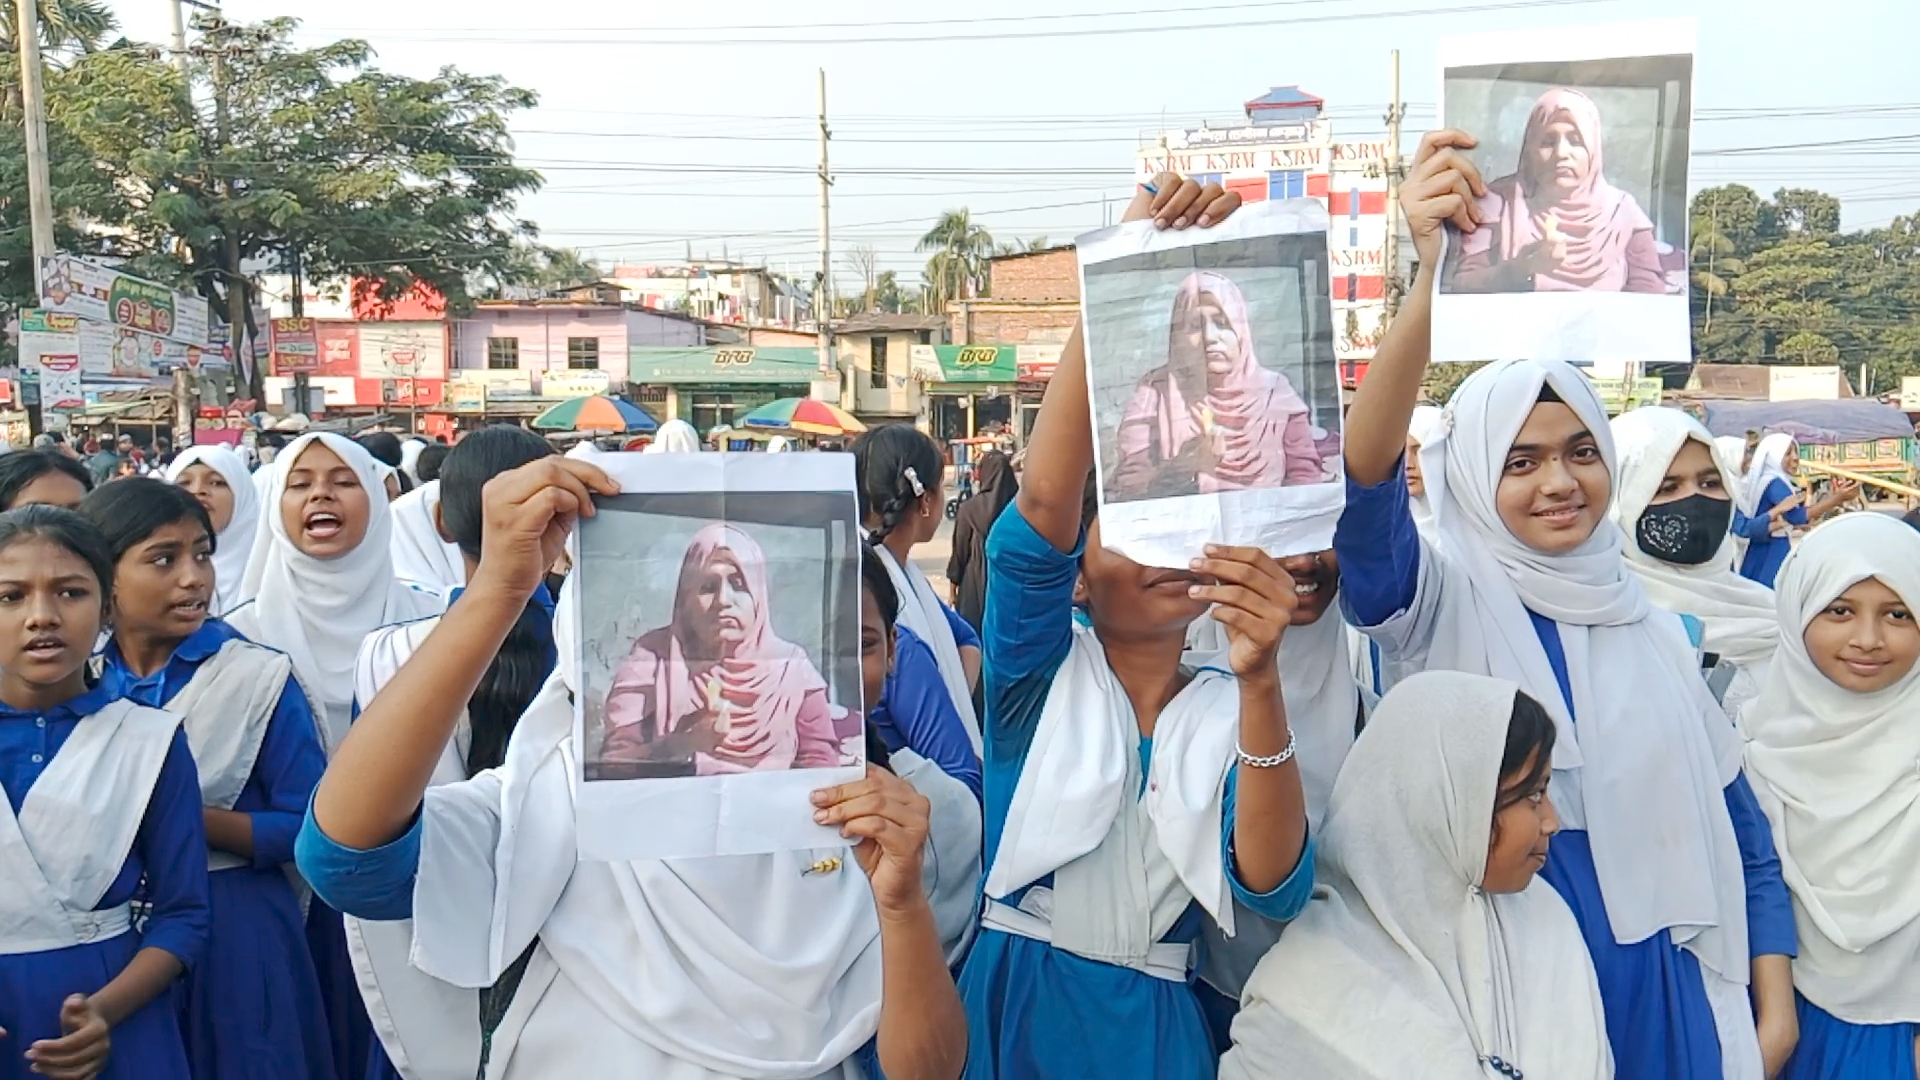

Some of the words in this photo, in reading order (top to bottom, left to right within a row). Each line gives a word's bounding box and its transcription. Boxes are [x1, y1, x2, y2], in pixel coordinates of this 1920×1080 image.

[1271, 148, 1320, 167] KSRM
[1332, 143, 1385, 160] KSRM
[1144, 155, 1191, 173] KSRM
[1207, 152, 1255, 170] KSRM
[278, 319, 310, 332] SSC
[714, 350, 754, 365] BRB
[959, 348, 996, 364] BRB
